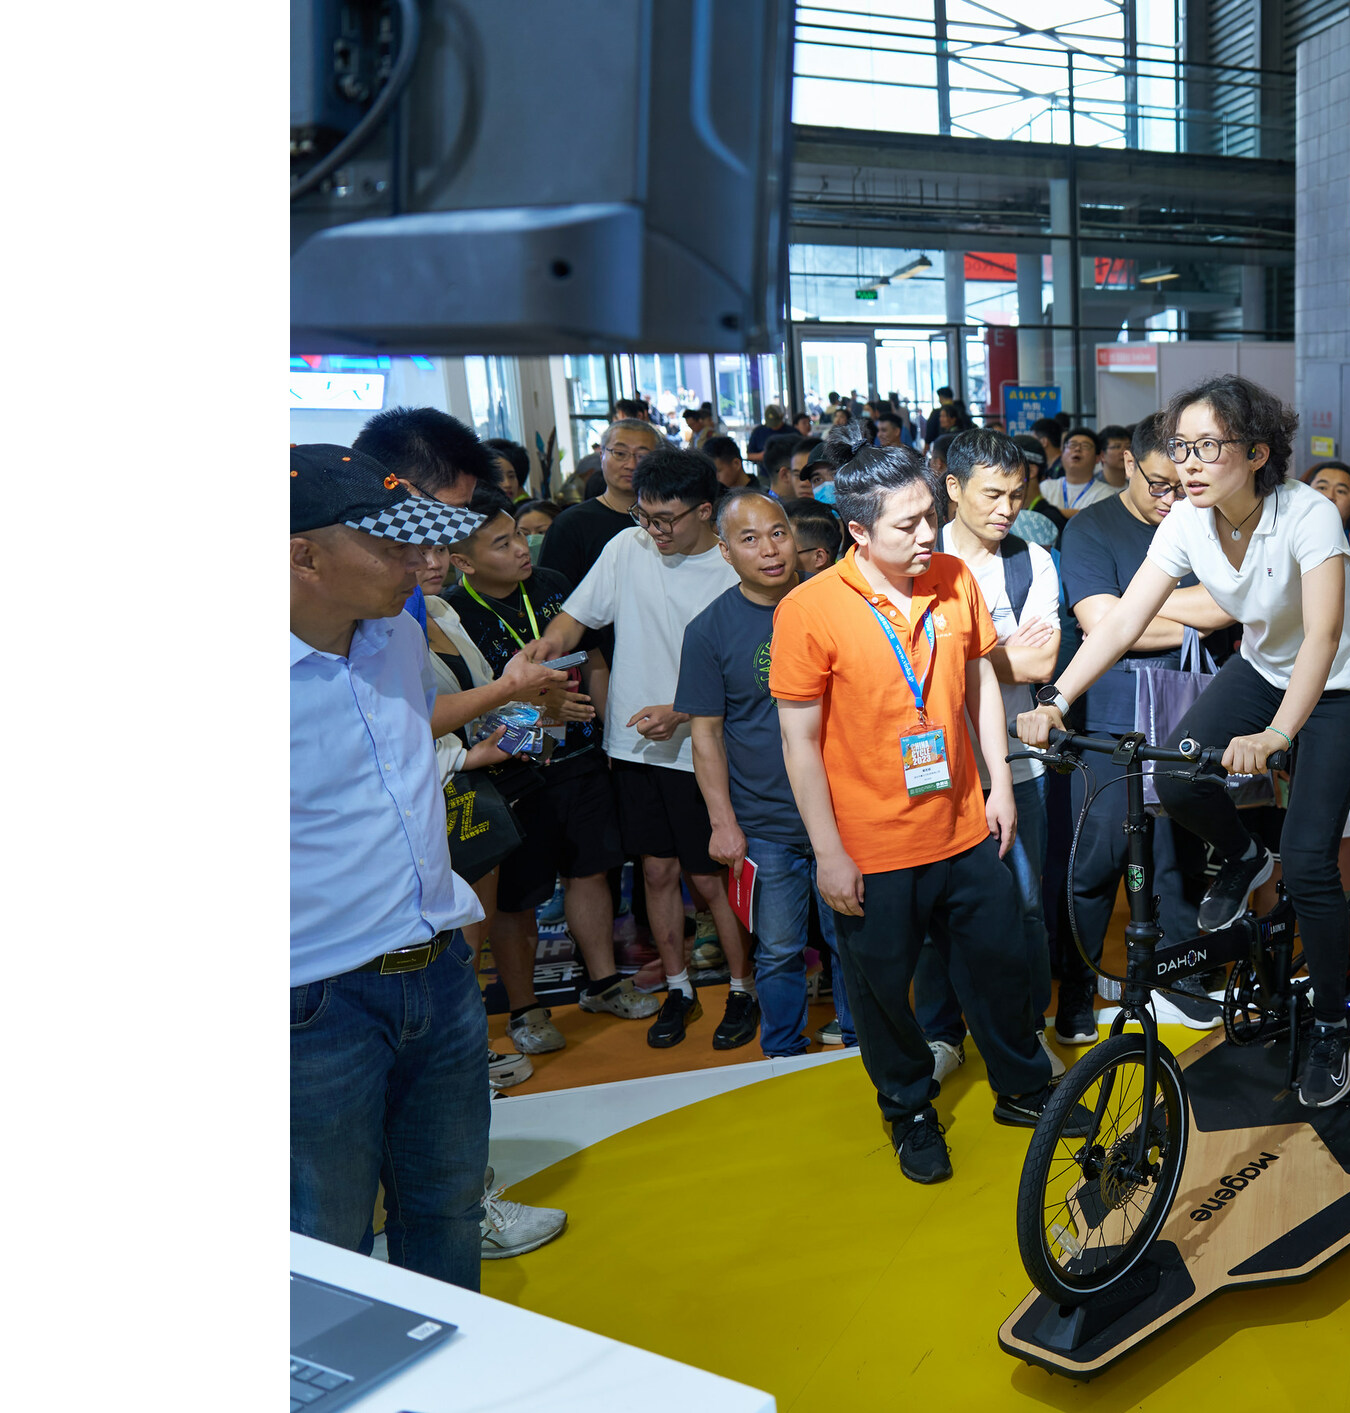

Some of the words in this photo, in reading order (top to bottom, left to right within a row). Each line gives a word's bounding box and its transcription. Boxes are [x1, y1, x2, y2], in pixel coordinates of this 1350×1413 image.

[910, 740, 929, 750] CHINA
[912, 755, 932, 766] 2023
[1157, 949, 1208, 976] DAHON
[1189, 1151, 1280, 1222] Magene
